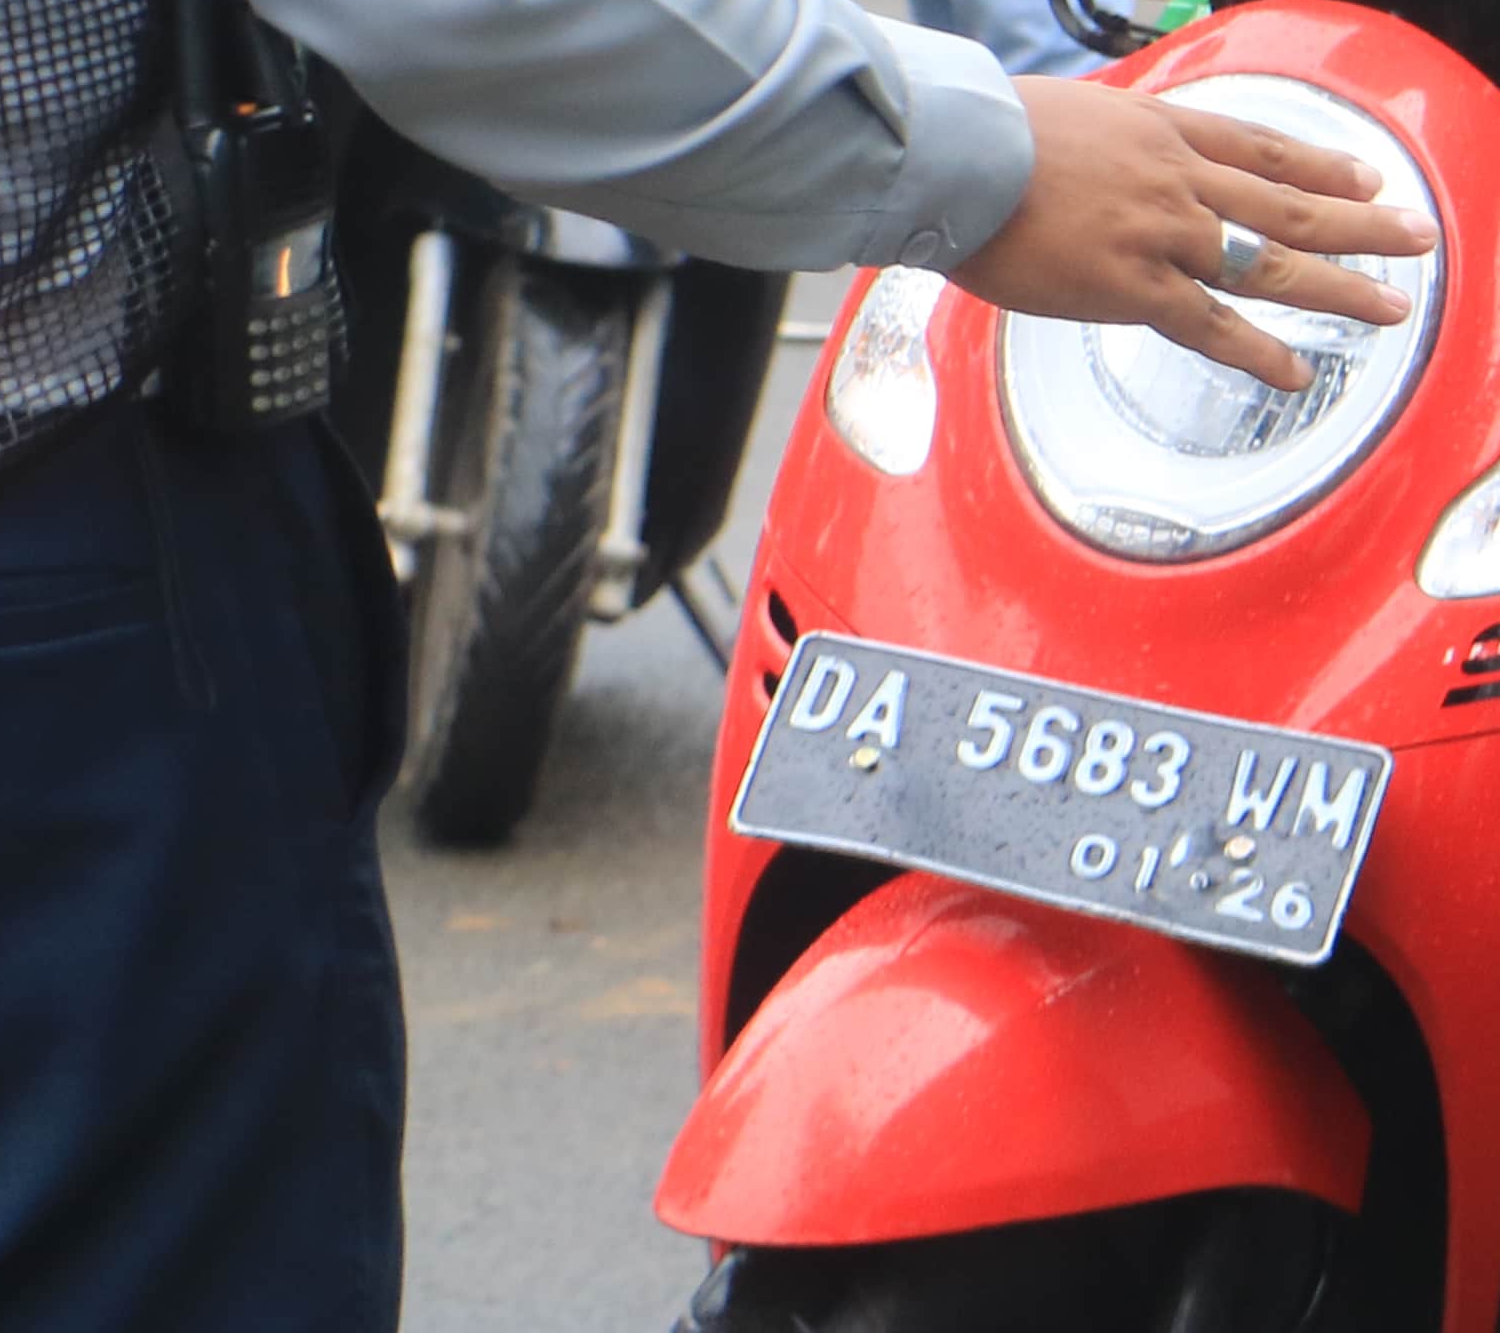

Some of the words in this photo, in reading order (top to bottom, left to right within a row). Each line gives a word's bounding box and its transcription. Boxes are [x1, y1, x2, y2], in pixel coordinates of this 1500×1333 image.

[789, 654, 910, 749] DA
[957, 690, 1191, 809] 5683
[1227, 749, 1368, 851] WM
